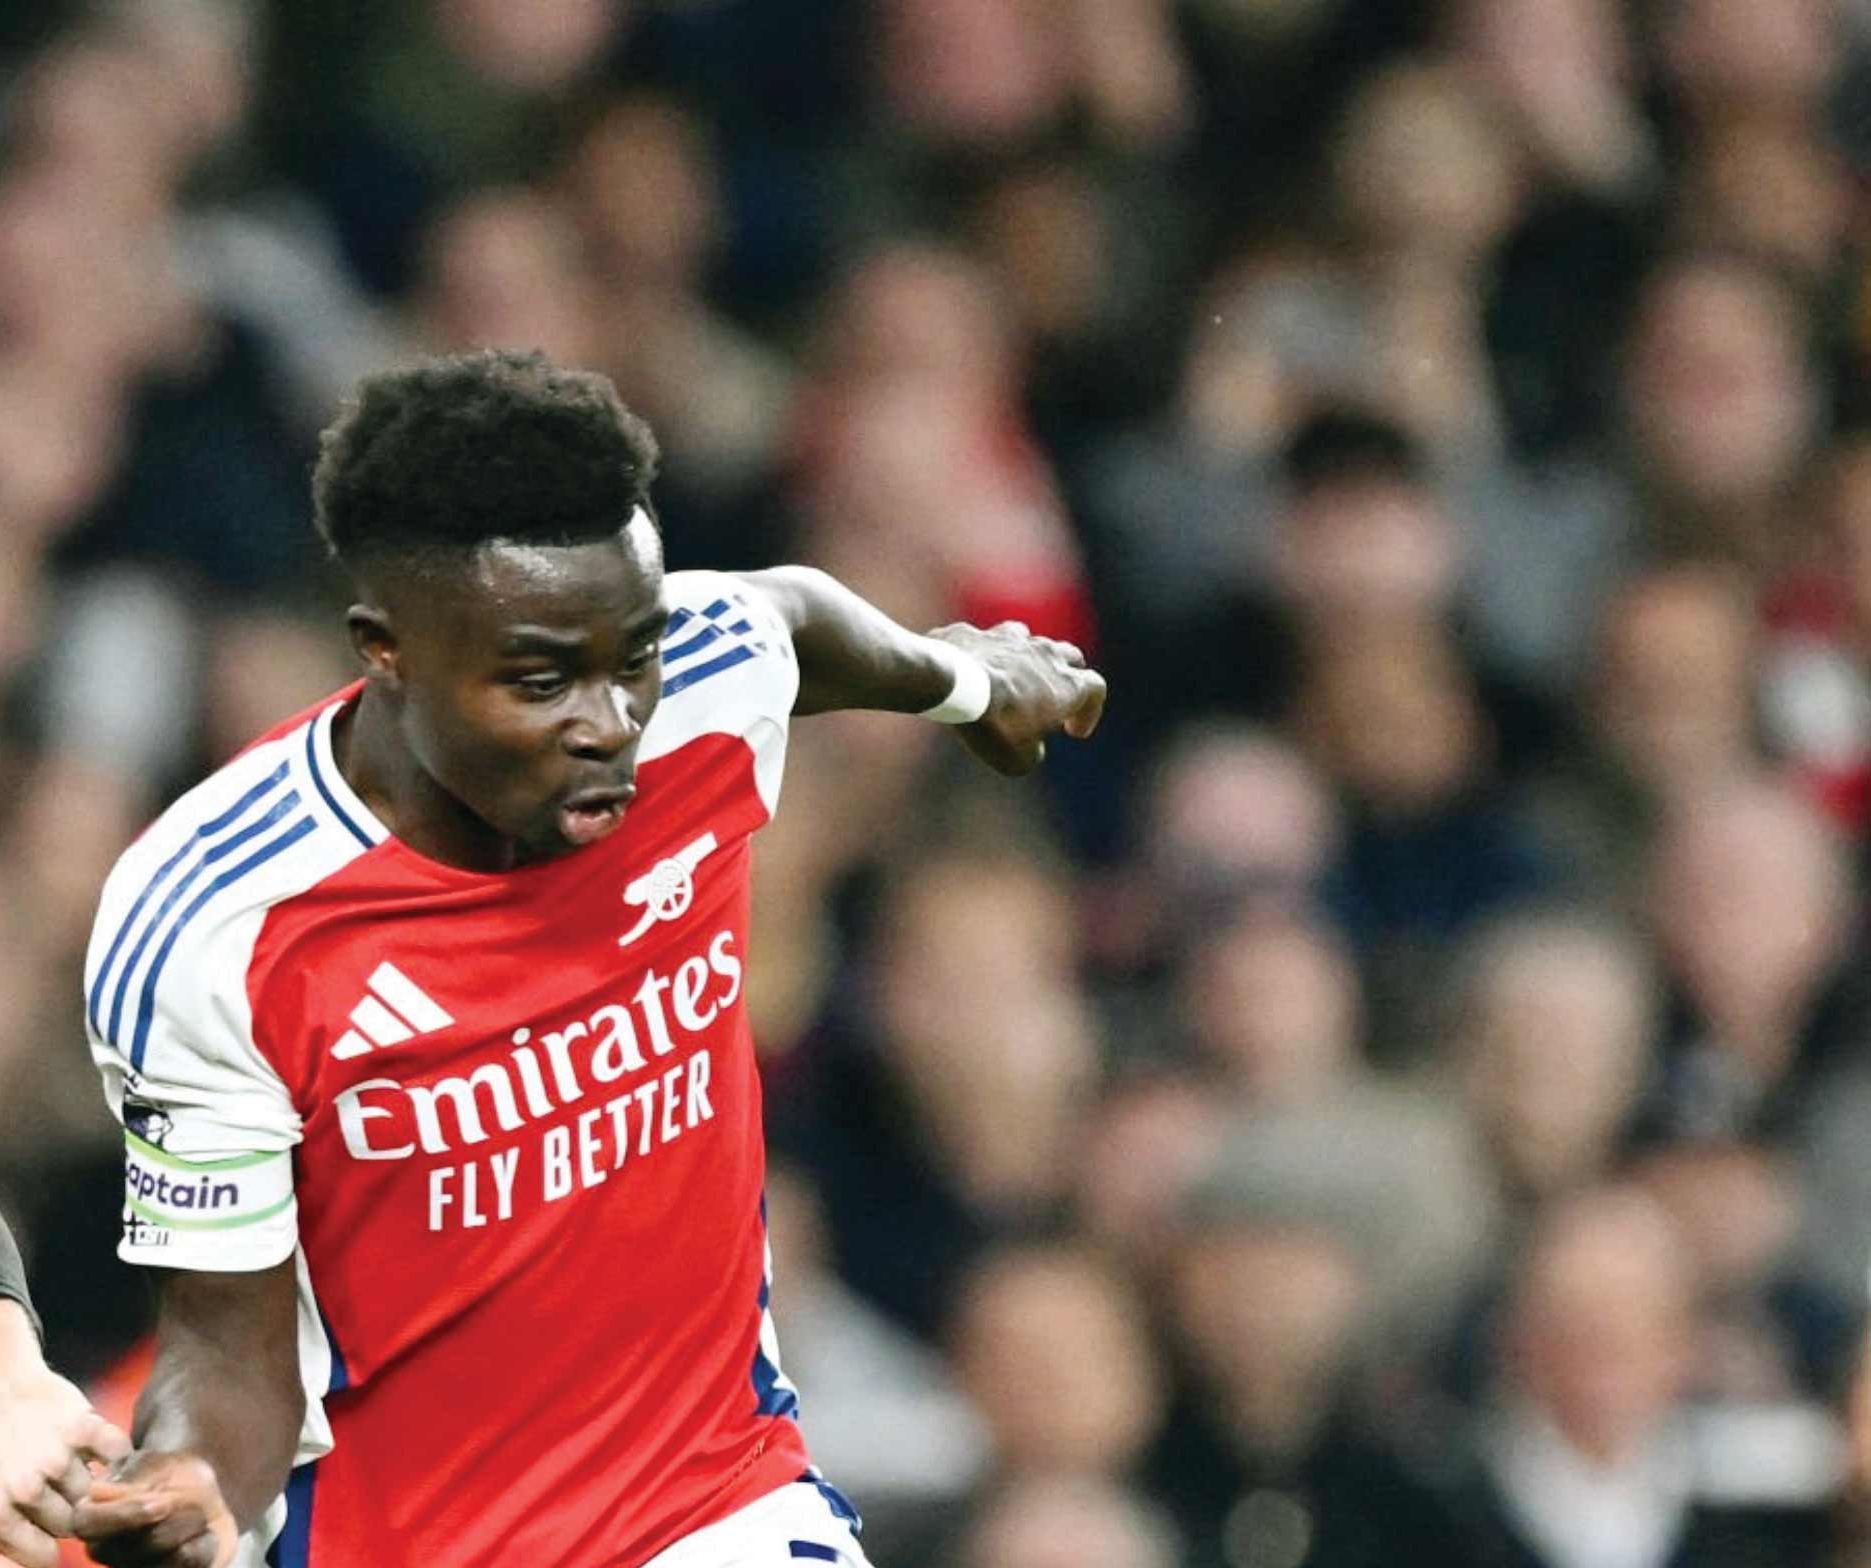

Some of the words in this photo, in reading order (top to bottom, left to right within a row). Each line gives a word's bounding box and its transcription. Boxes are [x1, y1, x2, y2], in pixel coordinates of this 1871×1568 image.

[333, 930, 742, 1161] Emirates
[126, 1162, 239, 1209] aptain
[429, 1147, 520, 1231] FLY
[543, 1050, 715, 1202] BETTER
